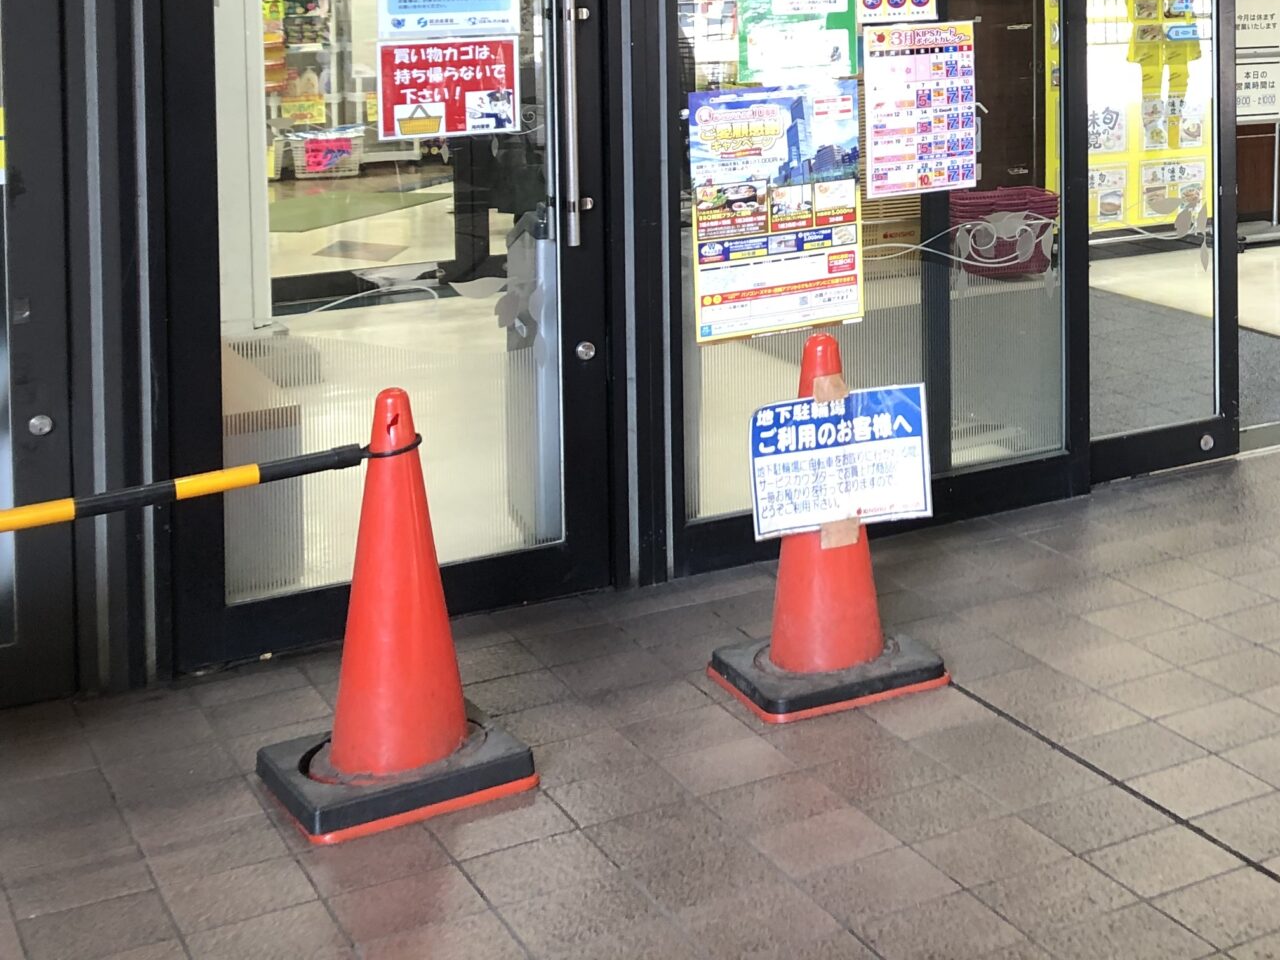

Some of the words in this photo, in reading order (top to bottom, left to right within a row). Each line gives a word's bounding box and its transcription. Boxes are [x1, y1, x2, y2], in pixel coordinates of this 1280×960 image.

[1237, 13, 1276, 21] 今月は休まず
[890, 29, 915, 46] 3月
[915, 28, 955, 37] KIPSカード
[394, 45, 496, 64] 買い物カゴは、
[394, 64, 506, 85] 持ち帰らないで
[1244, 71, 1268, 79] 本日の
[400, 87, 461, 104] 下さい！
[756, 399, 846, 427] 地下駐輪場
[758, 413, 913, 455] ご利用のお客様へ
